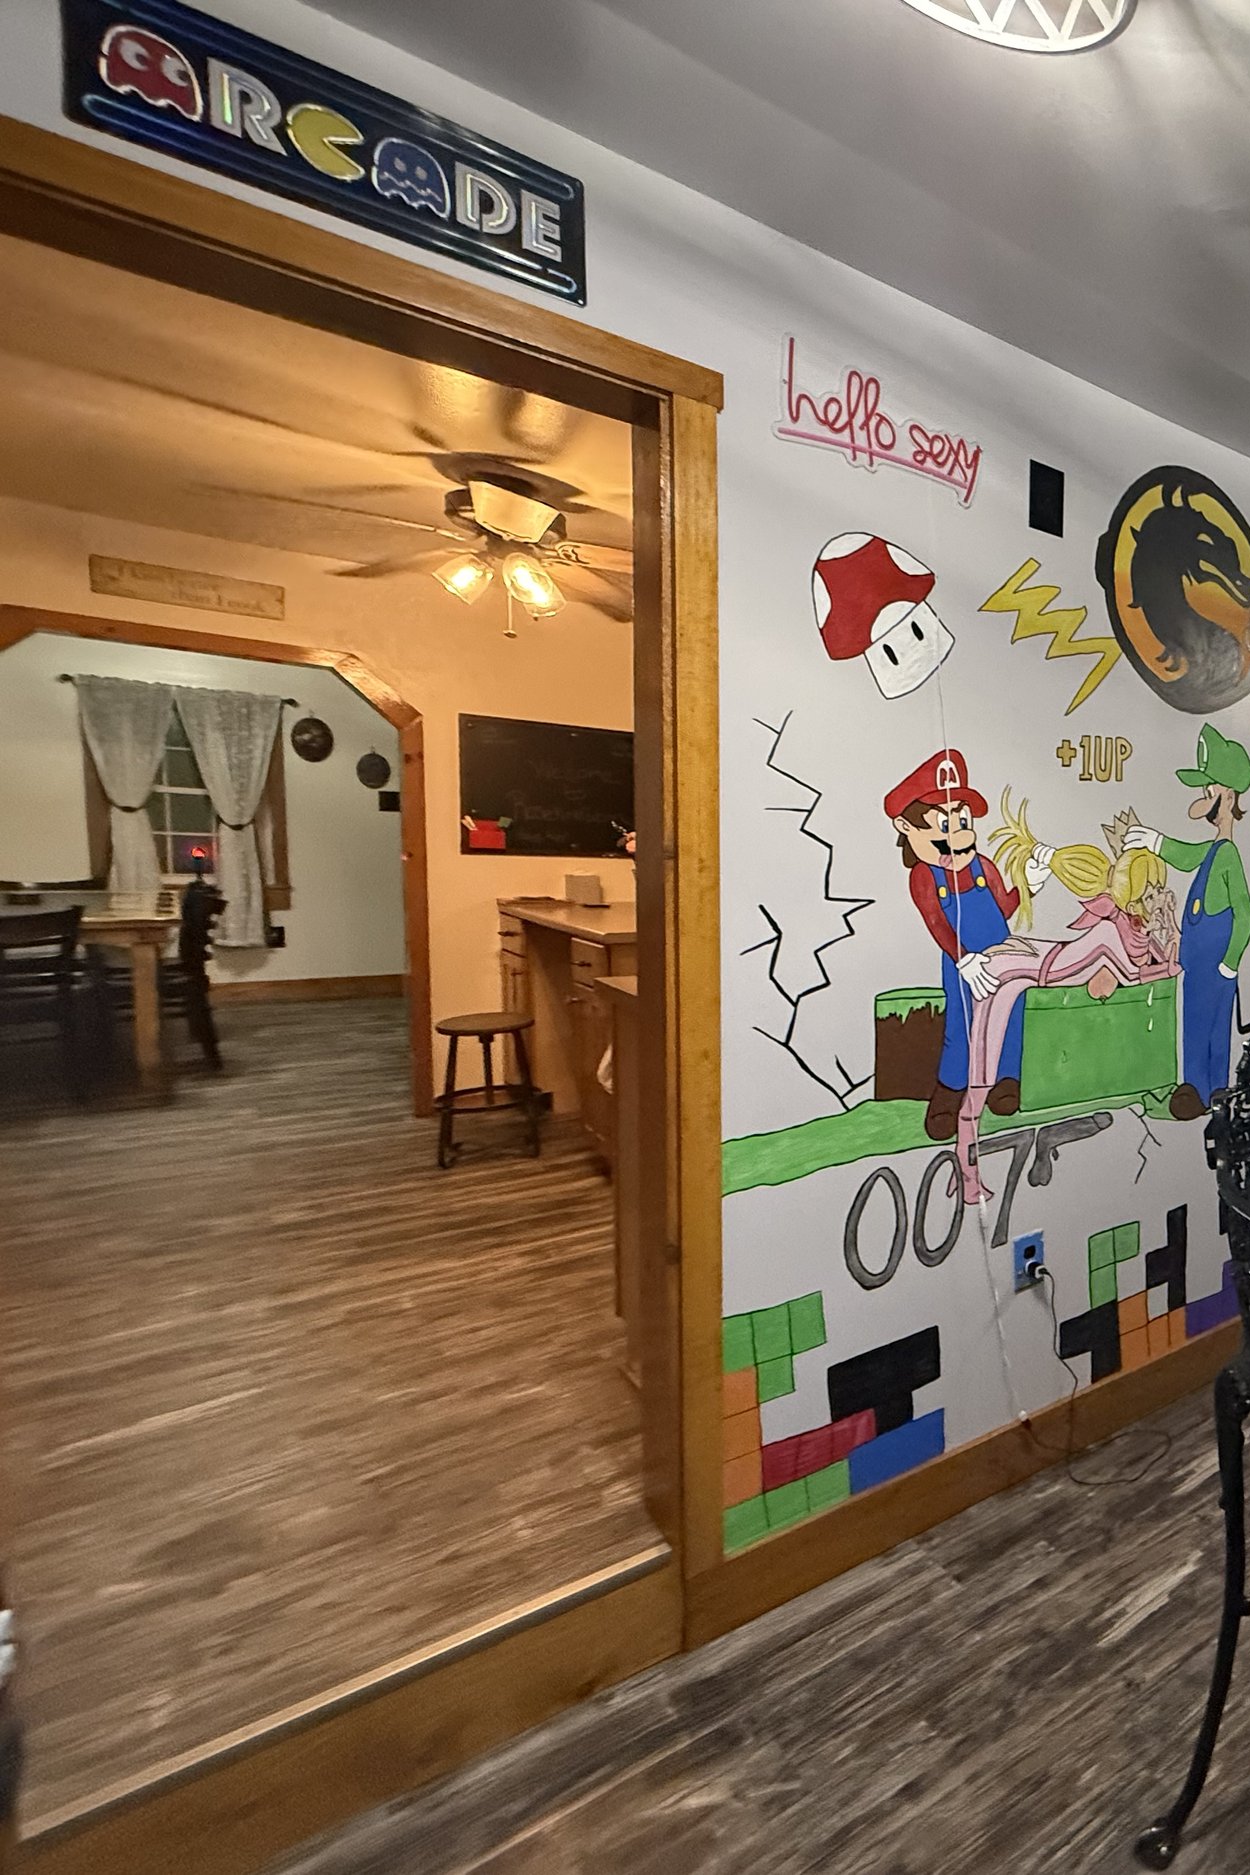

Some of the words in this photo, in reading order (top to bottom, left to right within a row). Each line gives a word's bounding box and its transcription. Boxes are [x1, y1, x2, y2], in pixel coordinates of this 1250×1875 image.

[788, 337, 896, 466] hello
[909, 424, 981, 502] sexy
[844, 1129, 1036, 1290] 007
